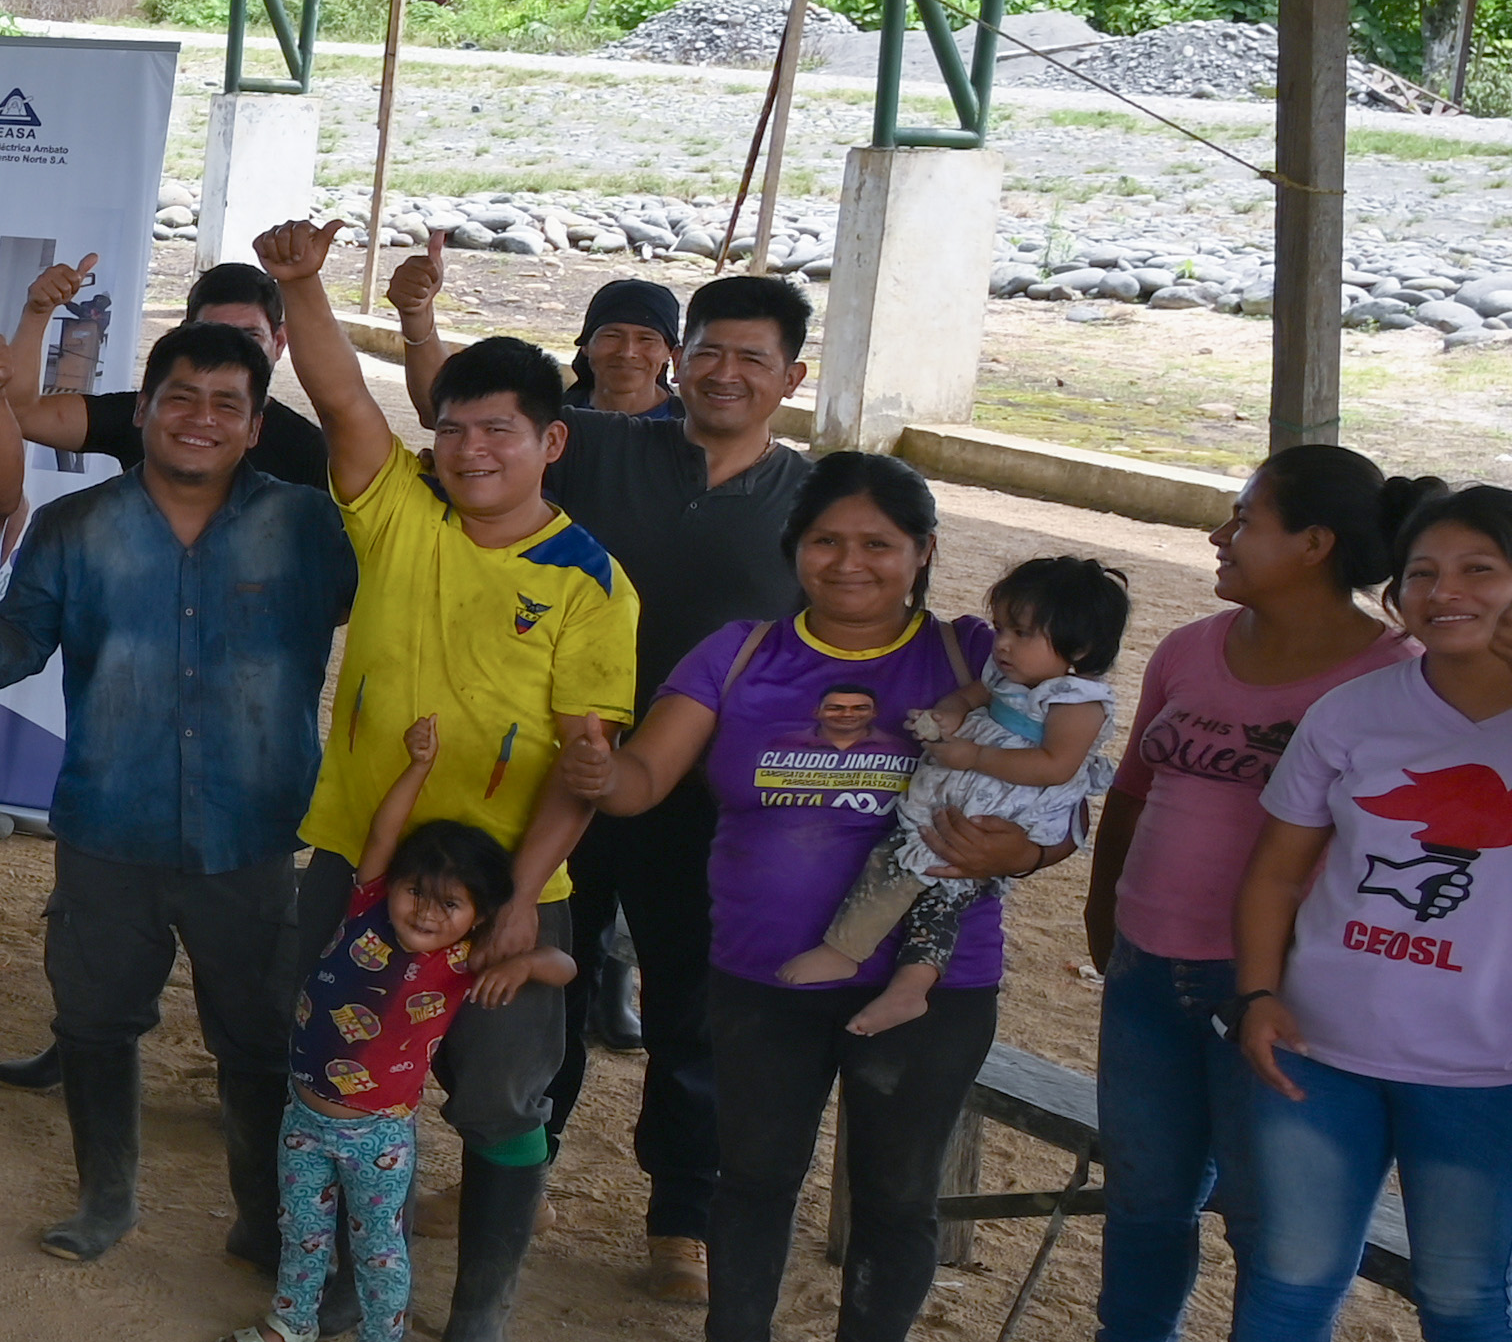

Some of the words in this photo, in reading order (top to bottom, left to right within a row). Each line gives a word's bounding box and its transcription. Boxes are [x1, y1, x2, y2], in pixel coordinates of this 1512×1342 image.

[33, 144, 69, 155] Ambato
[22, 155, 47, 164] Norte
[1191, 716, 1234, 736] HIS
[760, 750, 839, 769] CLAUDIO
[1343, 920, 1462, 972] CEOSL
